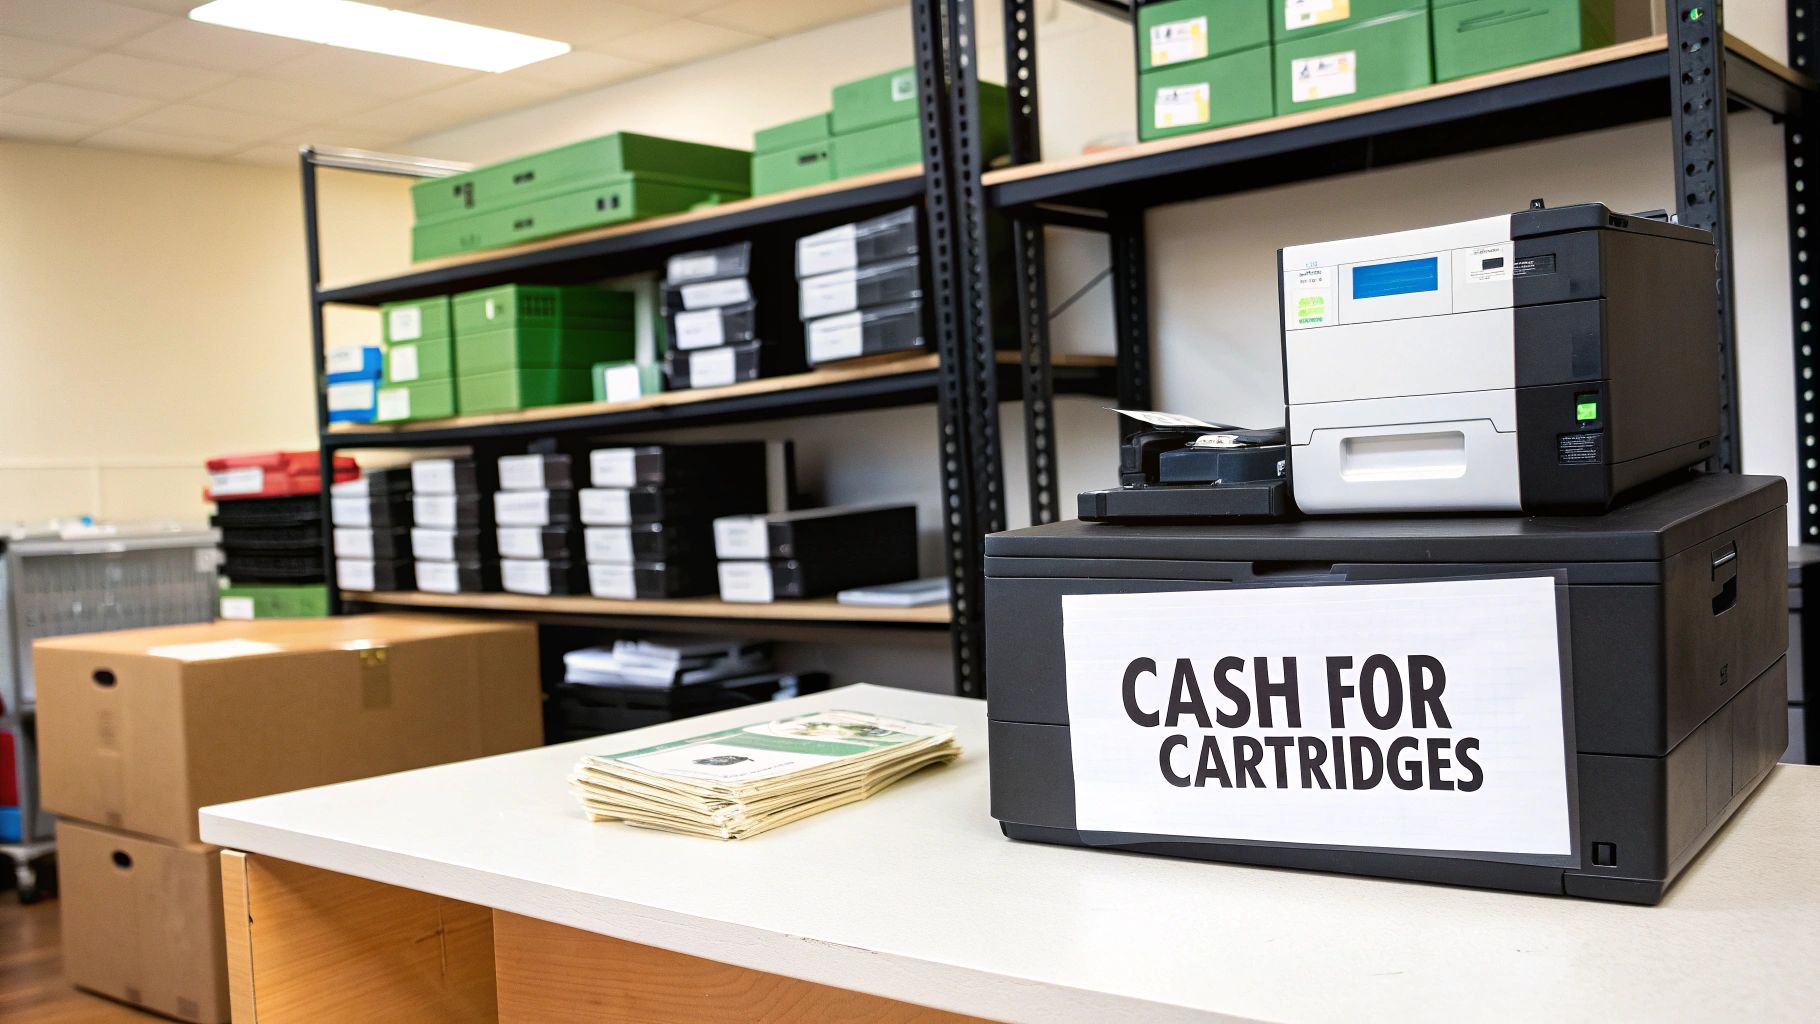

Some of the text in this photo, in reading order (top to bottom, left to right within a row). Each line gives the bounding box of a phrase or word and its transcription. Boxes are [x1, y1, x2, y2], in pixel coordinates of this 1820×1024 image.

[1121, 653, 1453, 731] CASH FOR
[1159, 734, 1484, 793] CARTRIDGES
